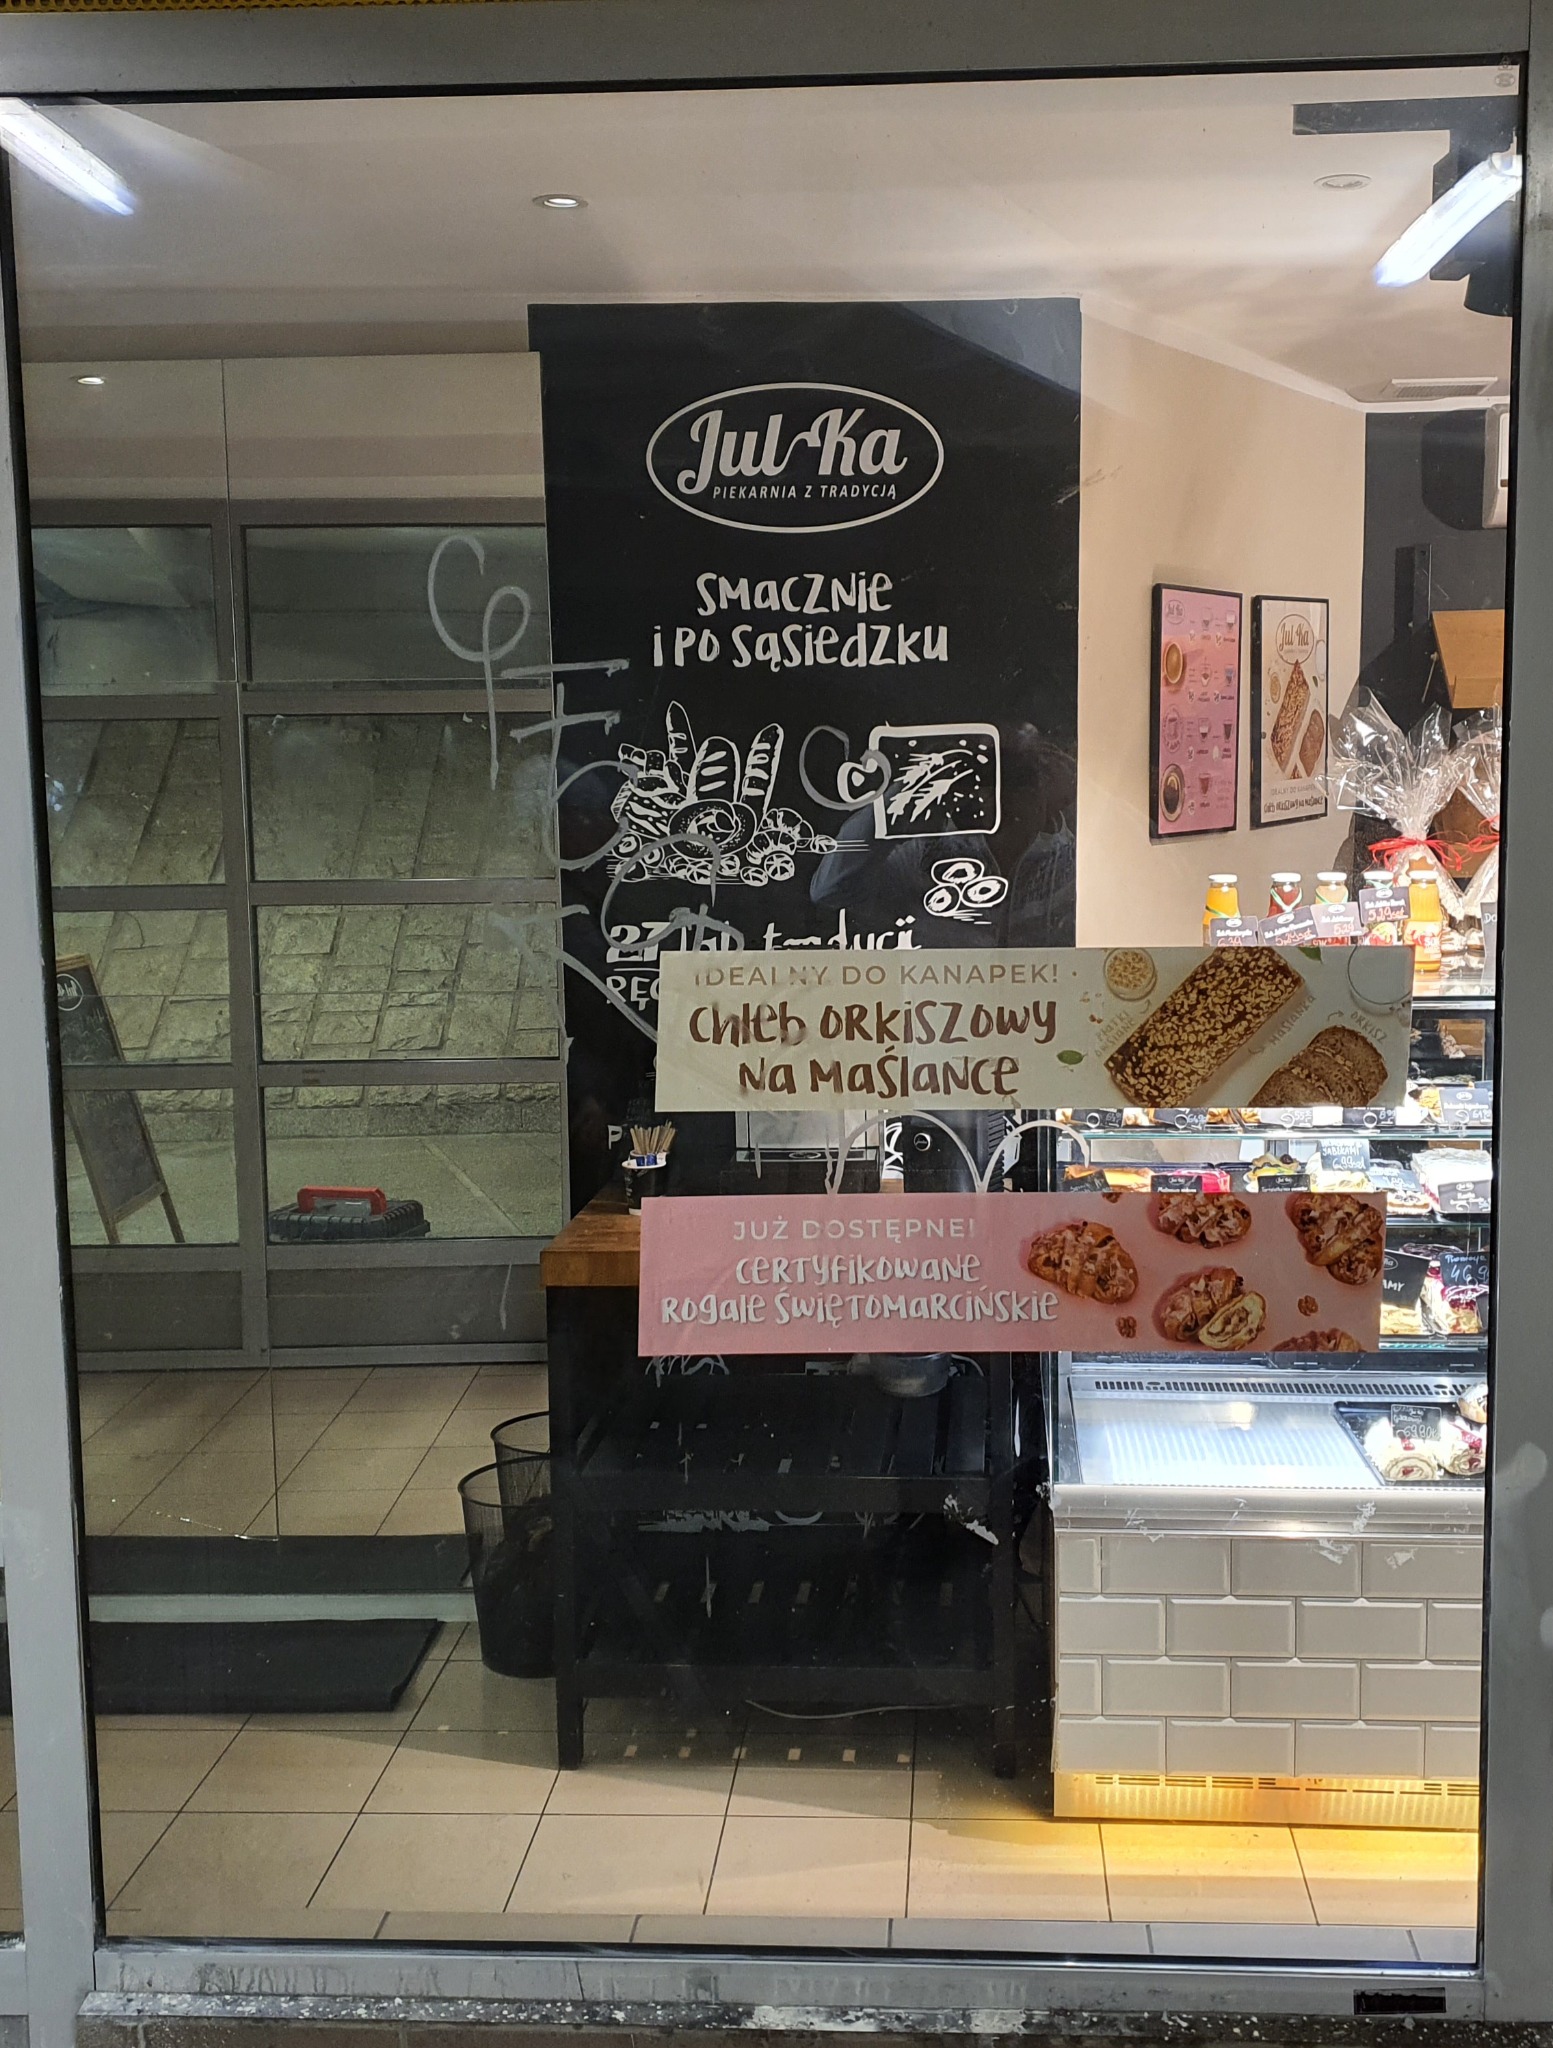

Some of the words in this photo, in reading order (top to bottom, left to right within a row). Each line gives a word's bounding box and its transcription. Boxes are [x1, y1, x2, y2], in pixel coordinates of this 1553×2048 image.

[713, 486, 797, 498] PIEKARNIA
[804, 486, 812, 498] Z
[820, 484, 896, 500] TRADYCJĄ
[695, 966, 828, 986] IDEALNY
[842, 965, 886, 985] DO
[900, 964, 1058, 984] KANAPEK!
[733, 1215, 789, 1241] JUŻ
[802, 1218, 976, 1243] DOSTĘPNE!
